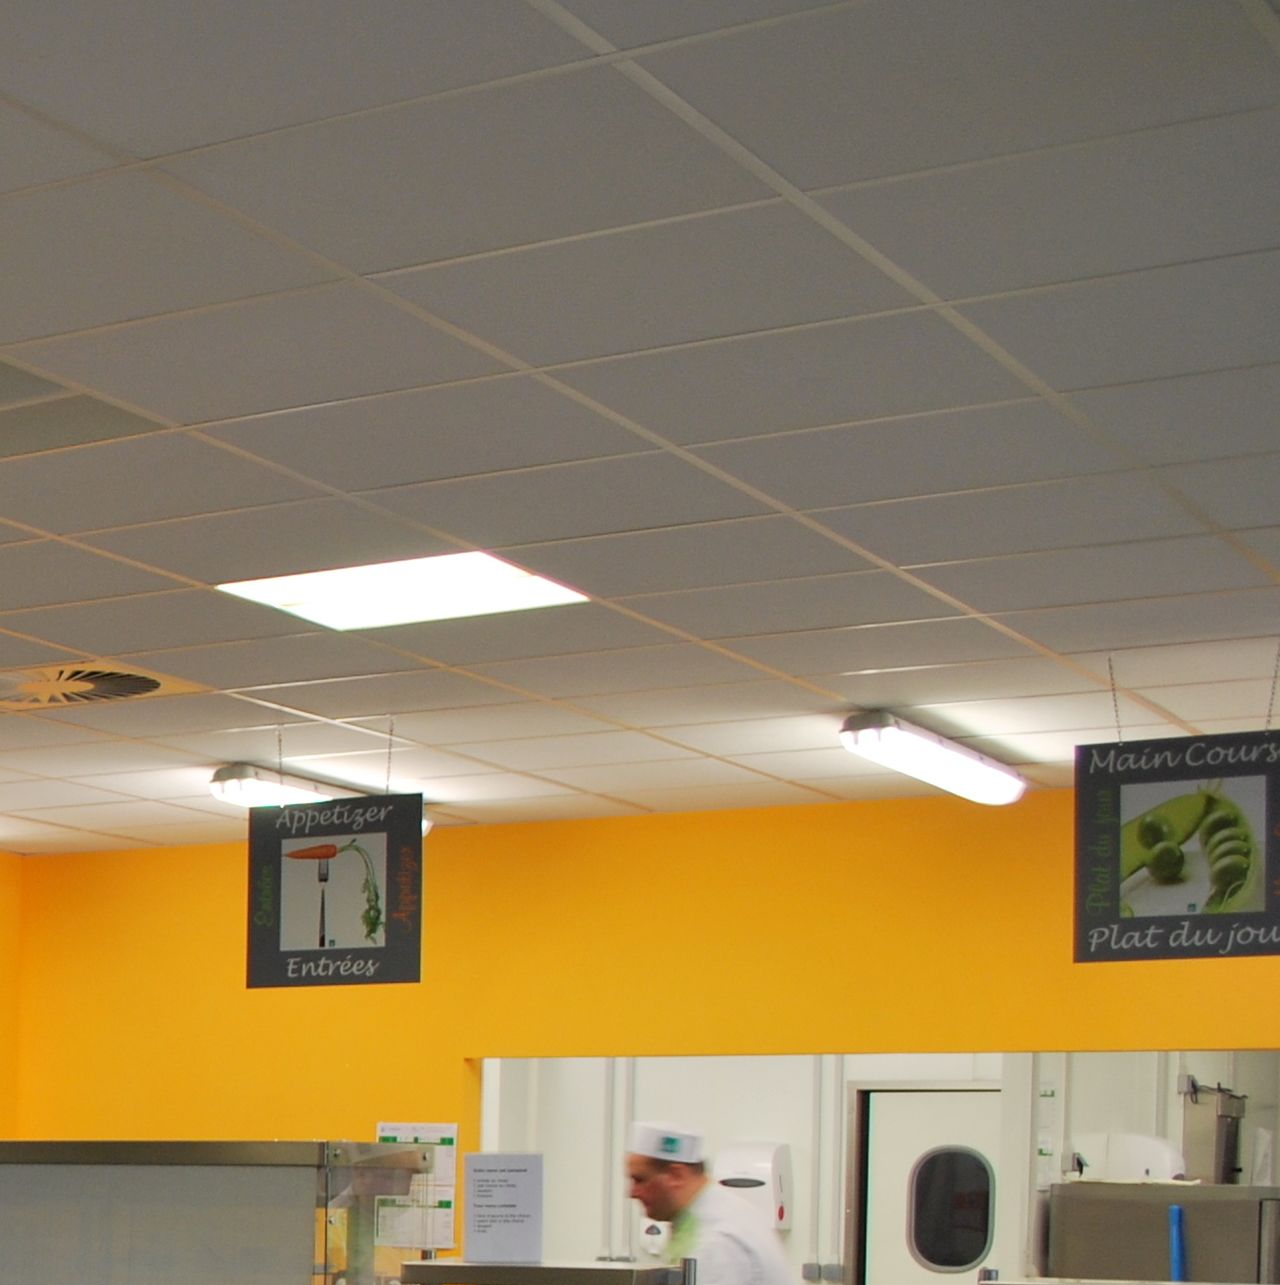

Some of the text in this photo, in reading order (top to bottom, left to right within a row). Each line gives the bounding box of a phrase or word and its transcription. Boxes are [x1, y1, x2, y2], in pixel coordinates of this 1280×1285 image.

[1089, 741, 1280, 774] Main Cours
[275, 803, 394, 835] Appetizer
[1088, 921, 1280, 955] Plat du jou
[286, 954, 380, 979] Entrées
